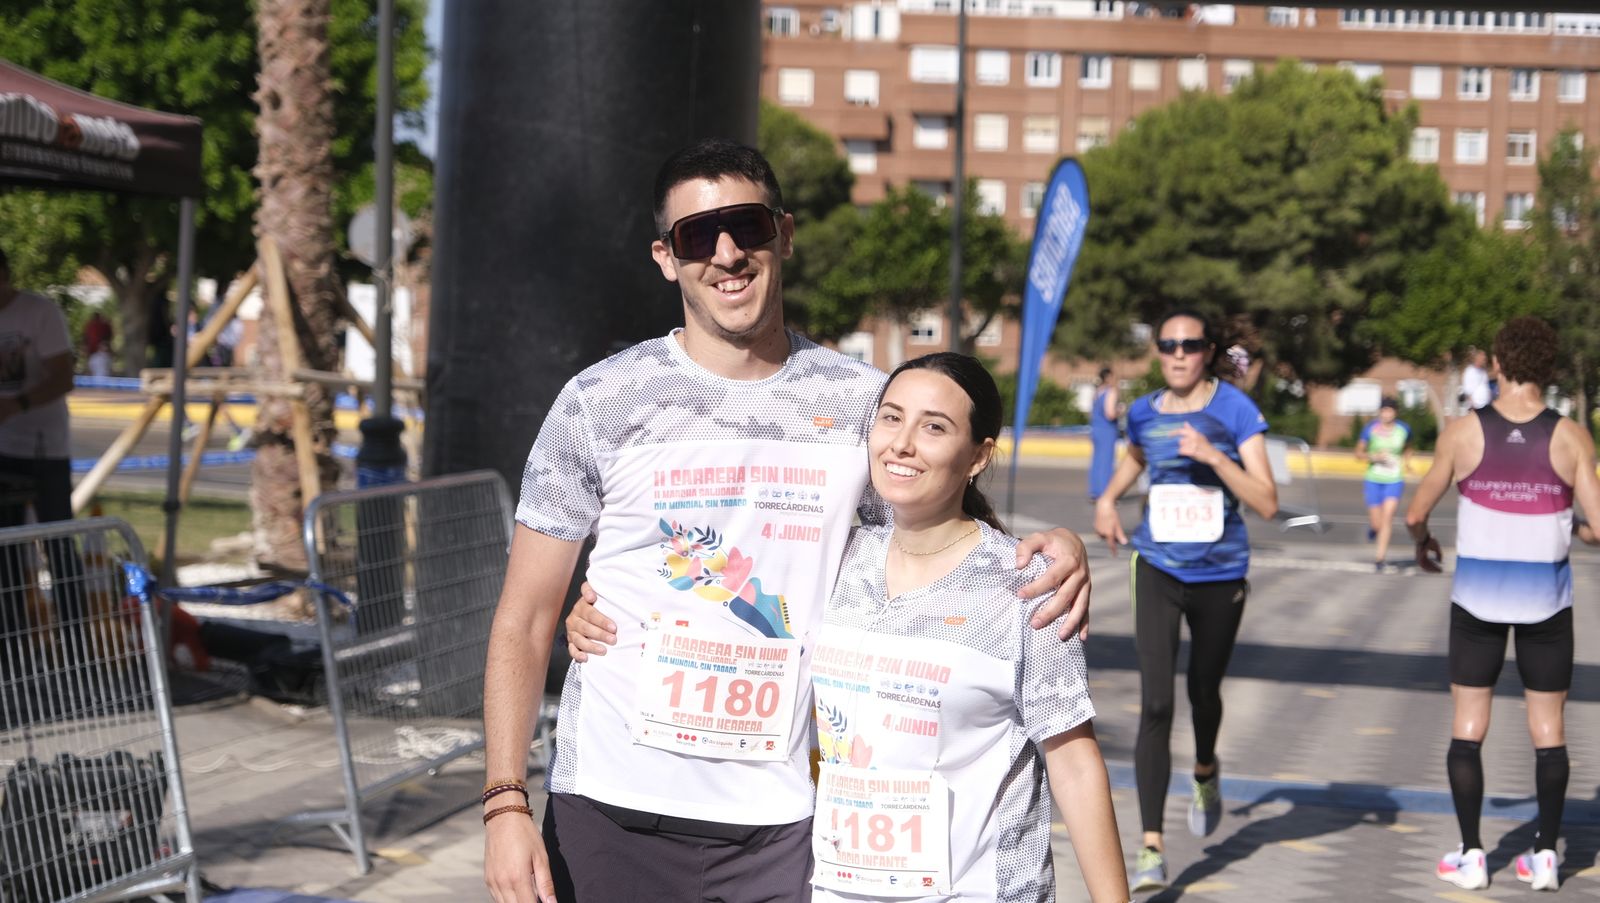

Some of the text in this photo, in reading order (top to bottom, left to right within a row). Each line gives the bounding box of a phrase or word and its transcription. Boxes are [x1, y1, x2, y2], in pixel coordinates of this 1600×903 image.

[654, 466, 827, 487] II CARRERA SIN HUMO
[662, 488, 697, 498] MARCHA
[699, 486, 745, 496] SALUDABLE
[669, 500, 703, 509] MUNDIAL
[705, 499, 719, 508] SIN
[720, 498, 747, 508] TABACO
[753, 500, 824, 514] TORRECÁRDENAS
[1159, 504, 1213, 524] 1163
[778, 524, 821, 542] JUNIO
[661, 633, 789, 662] II CARRERA SIN HUMO
[669, 656, 699, 669] MUNDIAL
[699, 662, 712, 671] SIN
[713, 663, 738, 675] TABACO
[875, 655, 903, 675] SIN
[904, 659, 952, 685] HUMO
[661, 670, 781, 719] 1180
[876, 690, 942, 709] TORRECÁRDENAS
[672, 711, 764, 733] SERGIO HERRERA
[895, 716, 938, 737] JUNIO
[868, 780, 889, 793] SIN
[892, 780, 931, 794] HUMO
[862, 853, 909, 869] INFANTE
